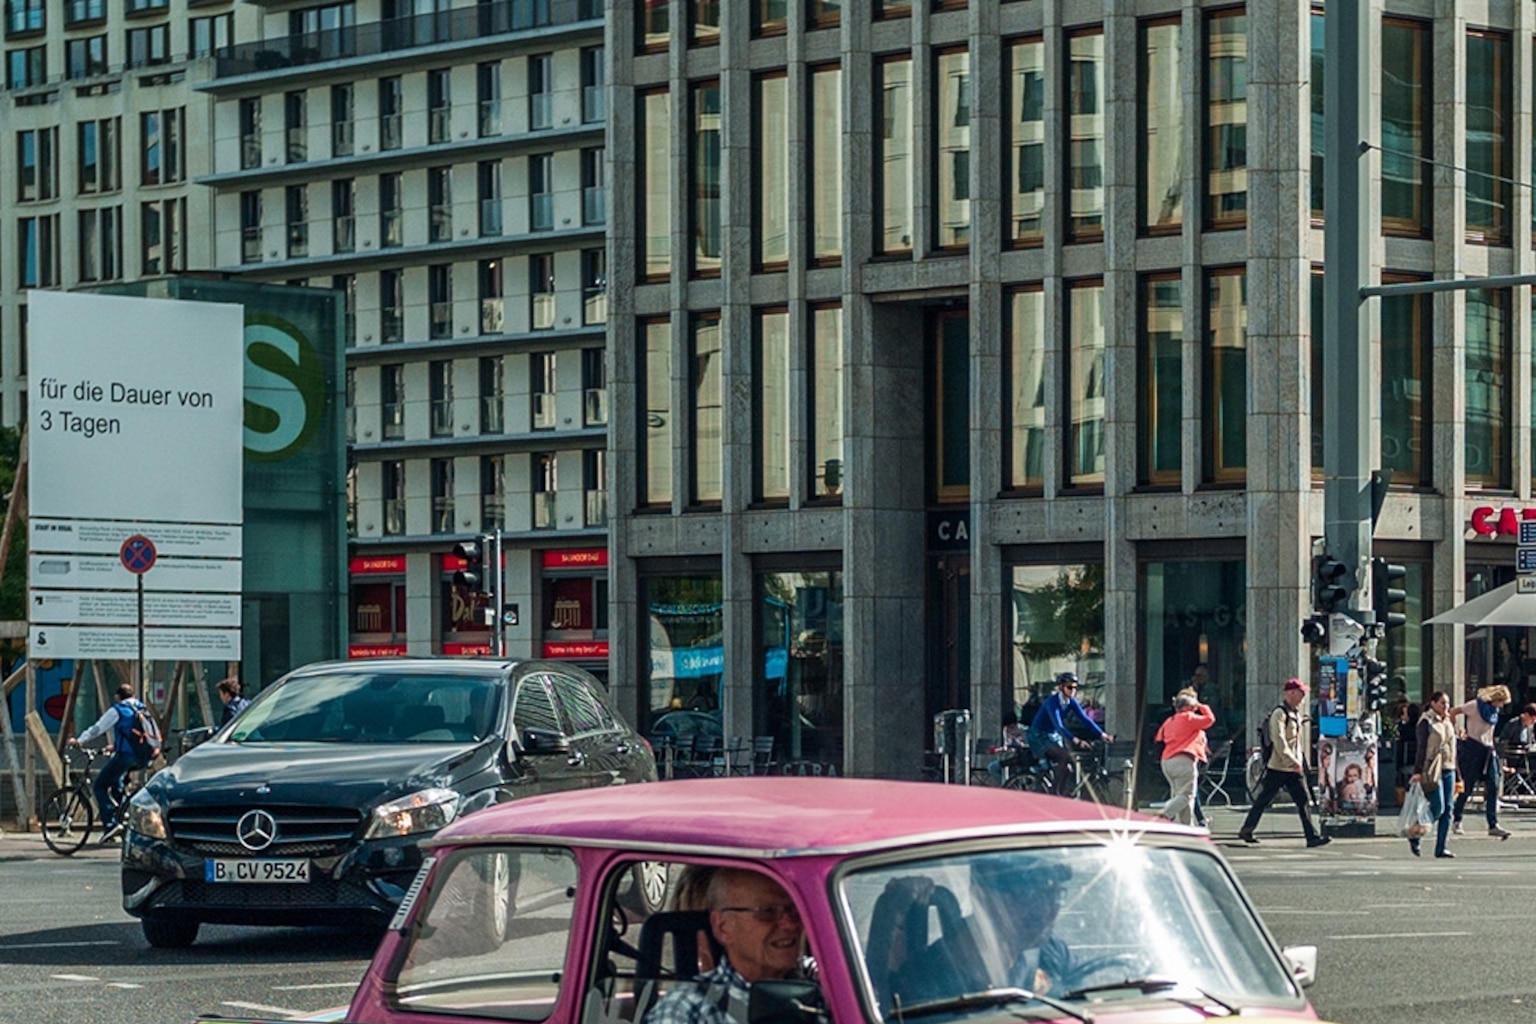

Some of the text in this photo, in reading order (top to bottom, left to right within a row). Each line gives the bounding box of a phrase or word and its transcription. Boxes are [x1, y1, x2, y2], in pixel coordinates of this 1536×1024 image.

[39, 378, 213, 408] für die Dauer von
[39, 410, 121, 438] 3 Tagen
[215, 862, 307, 880] B CV 9524
